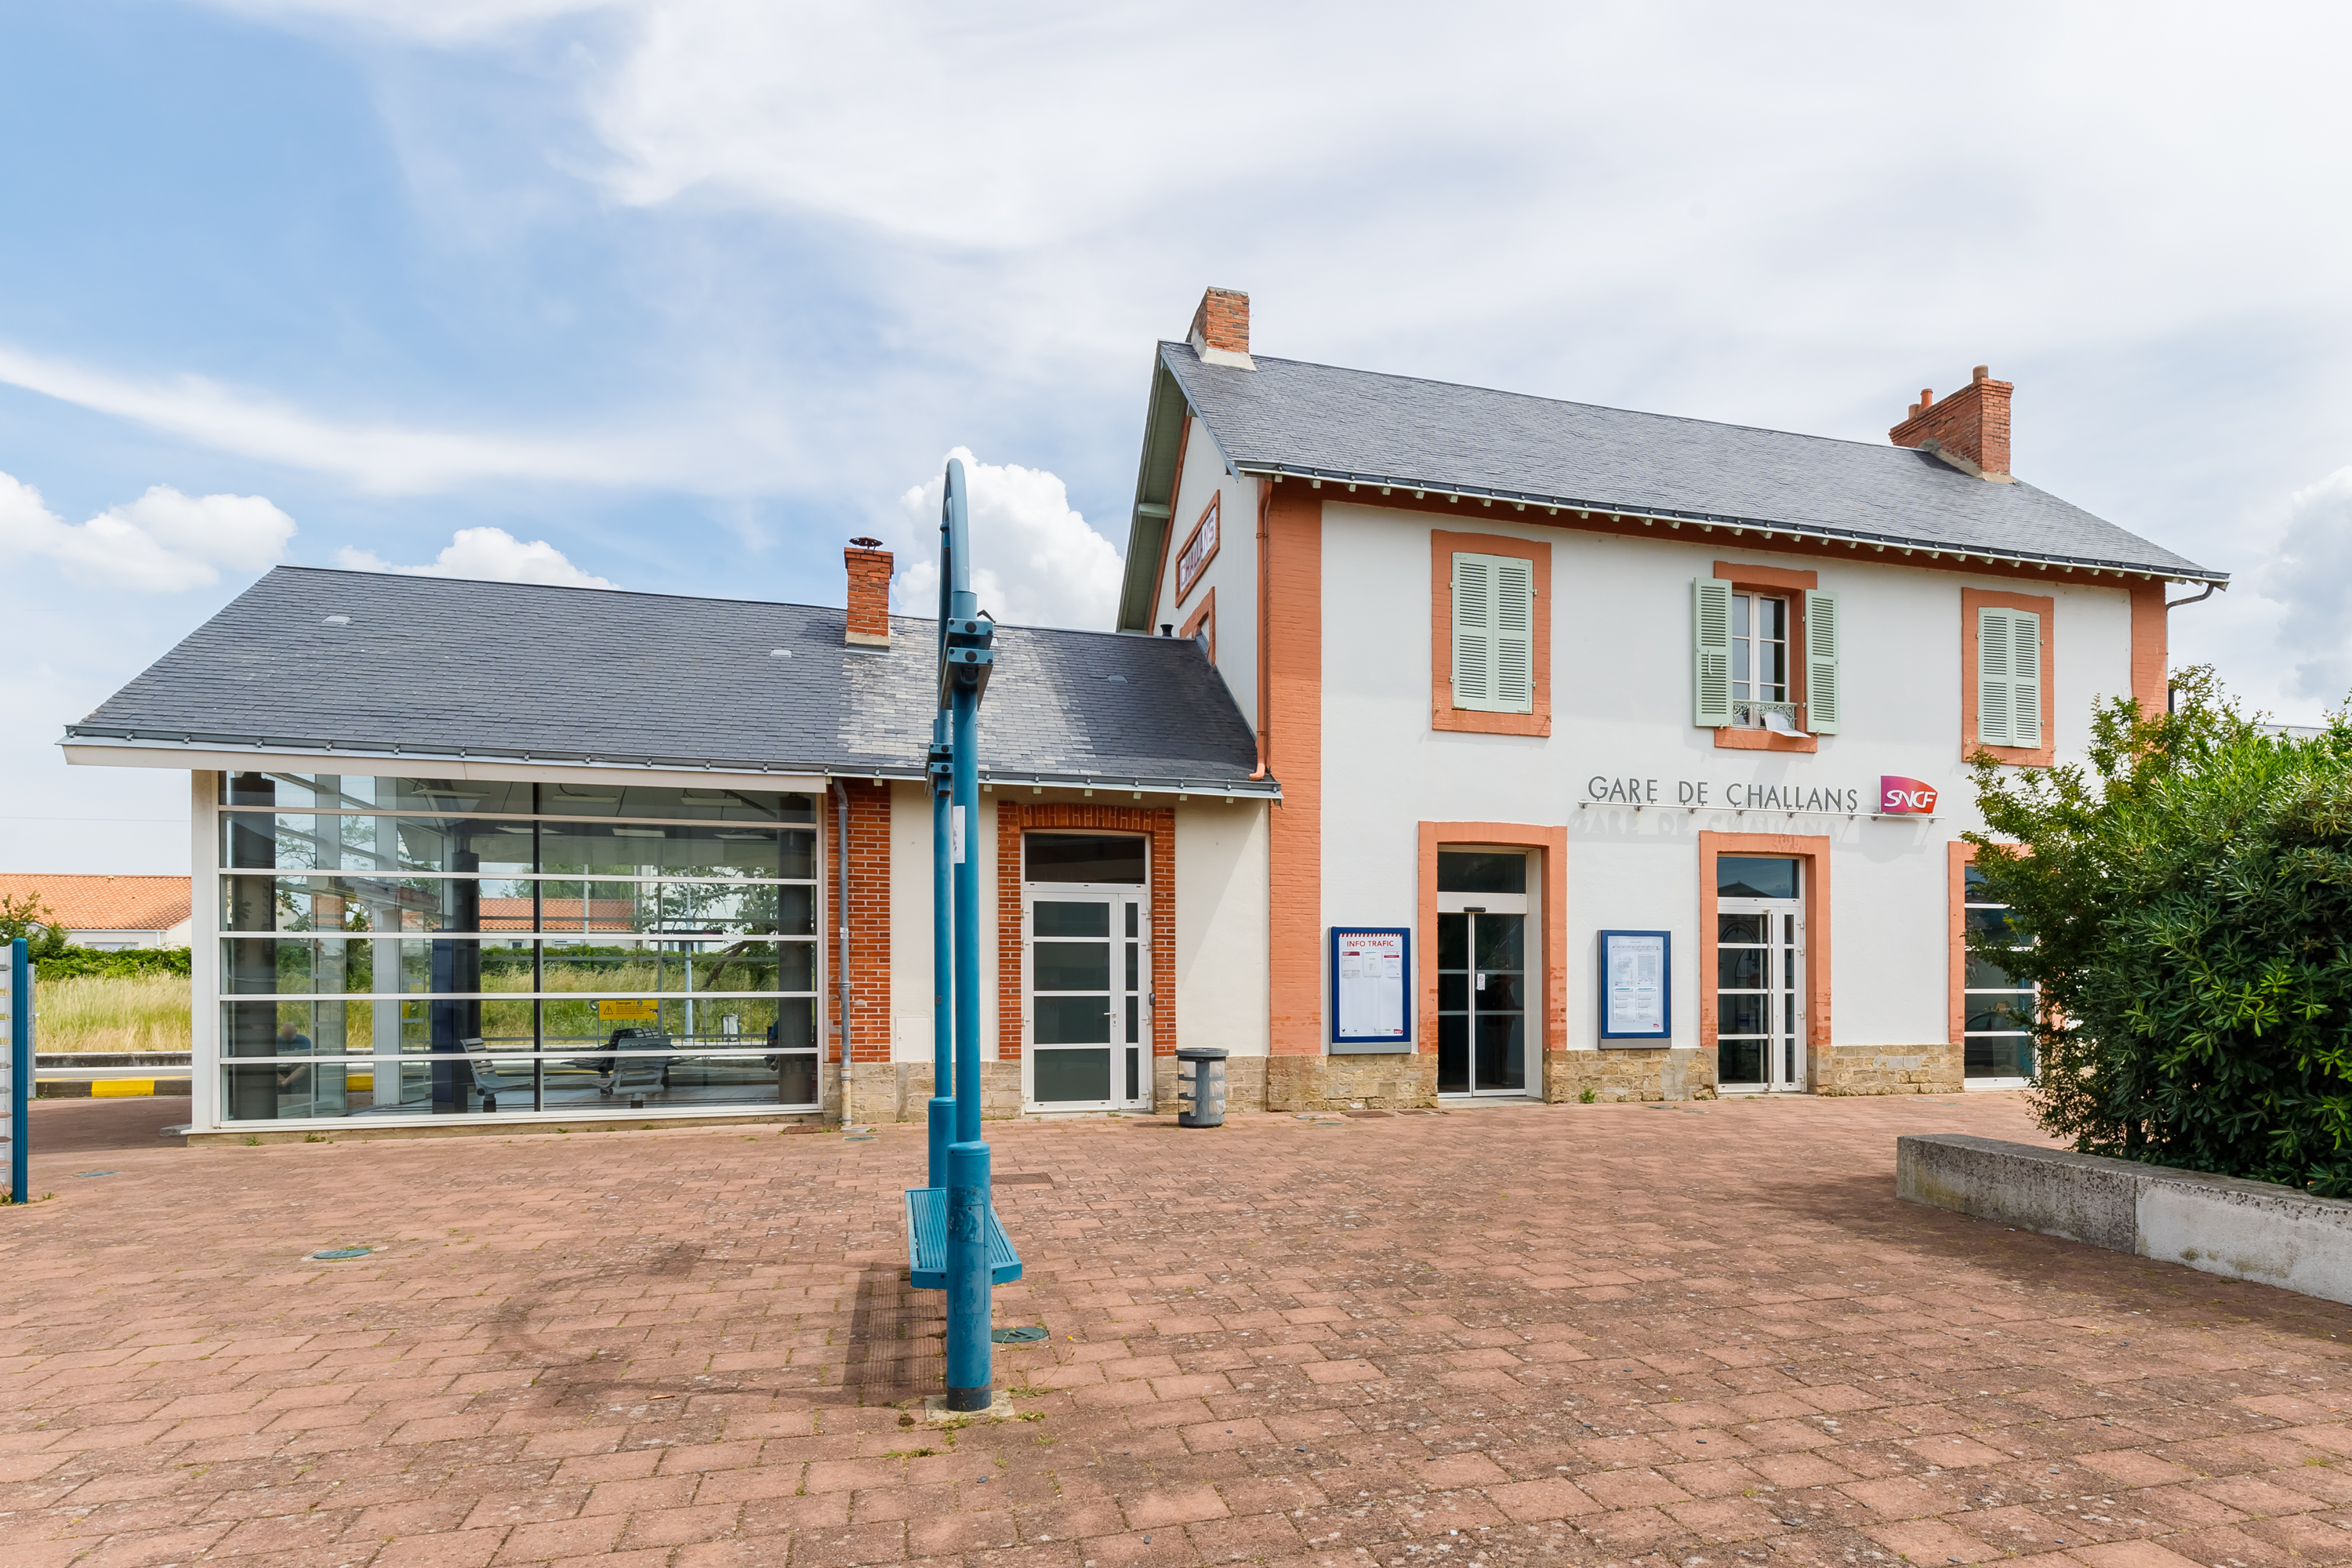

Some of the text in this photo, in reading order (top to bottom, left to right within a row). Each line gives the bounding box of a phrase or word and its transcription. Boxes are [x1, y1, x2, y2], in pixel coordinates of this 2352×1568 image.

[1588, 775, 1858, 811] GARE DE CHALLANS
[1883, 789, 1936, 808] SNCF
